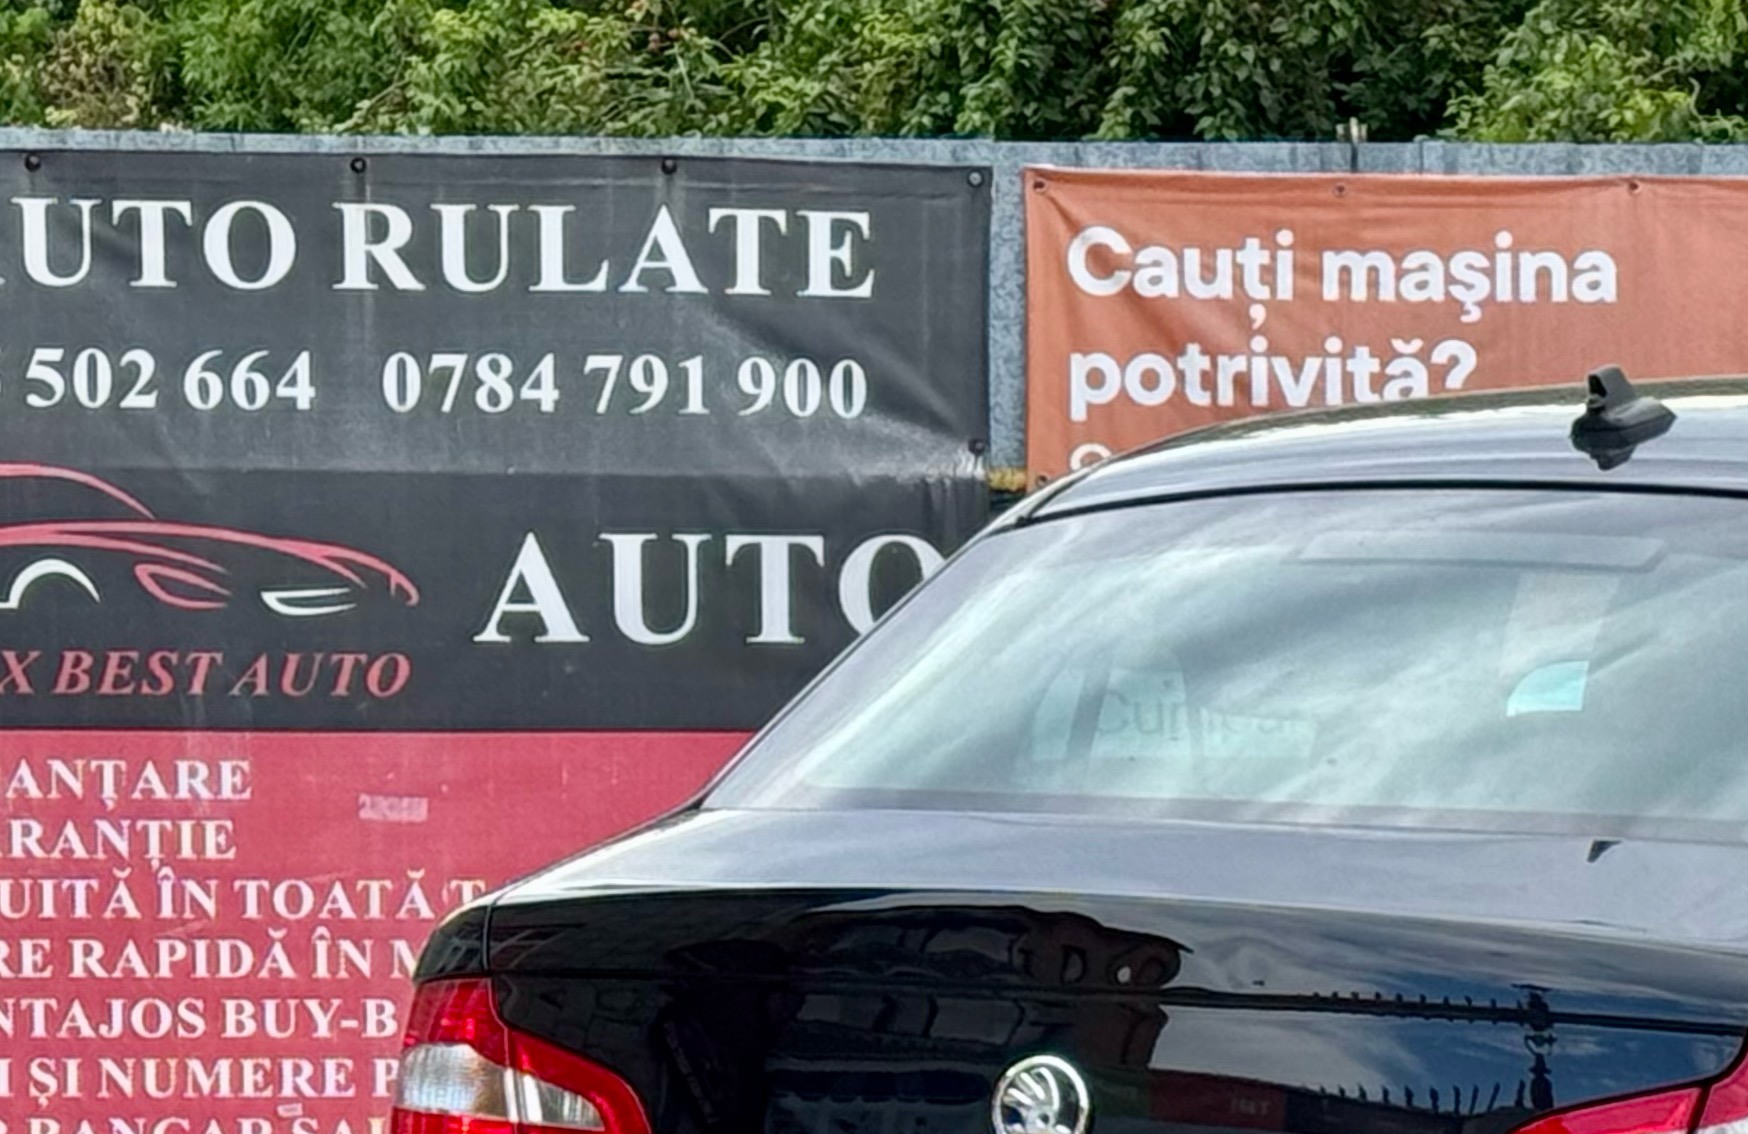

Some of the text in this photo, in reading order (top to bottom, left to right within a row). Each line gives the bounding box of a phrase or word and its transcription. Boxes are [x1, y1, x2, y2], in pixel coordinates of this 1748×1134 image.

[0, 196, 875, 298] UTO RULATE
[26, 348, 867, 420] 502 664 0784 791 900
[1068, 336, 1478, 421] potrivită?
[473, 532, 949, 647] AUTO
[0, 650, 411, 697] X BEST AUTO
[0, 819, 236, 871] RANȚIE
[0, 867, 141, 919] UITĂ
[158, 866, 218, 919] ÎN
[234, 868, 435, 920] TOATĂ
[69, 928, 297, 979] RAPIDĂ
[312, 926, 373, 979] ÎN
[222, 998, 398, 1039] BUY-B
[98, 1058, 355, 1098] NUMERE
